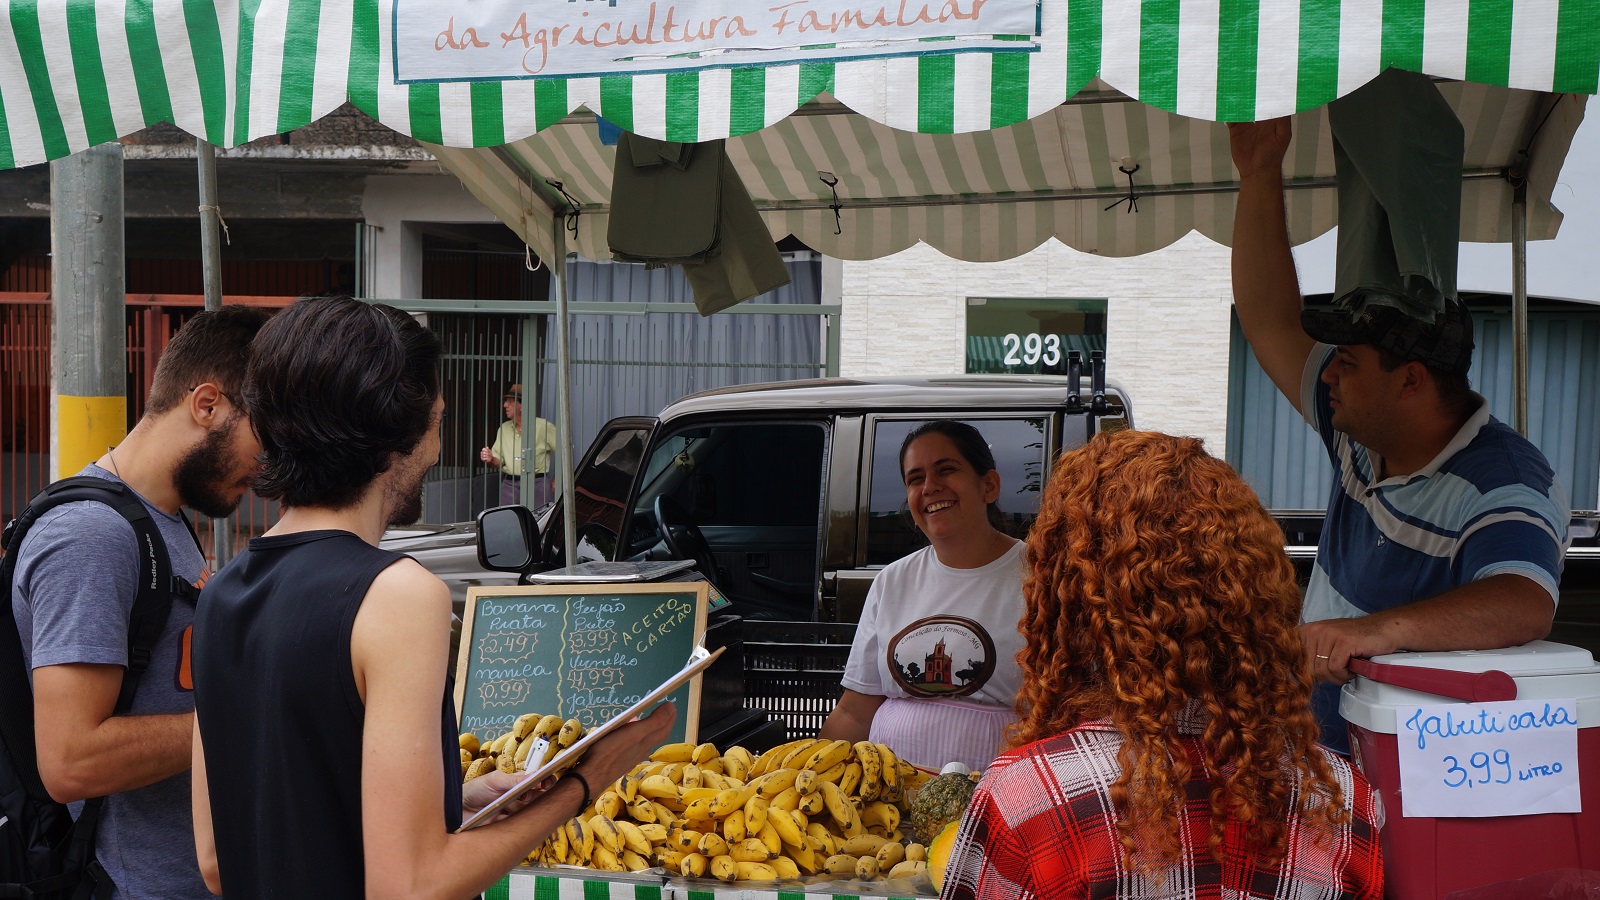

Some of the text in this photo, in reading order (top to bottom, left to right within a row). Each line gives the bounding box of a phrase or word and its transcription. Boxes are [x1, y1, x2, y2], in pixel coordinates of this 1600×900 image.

[434, 16, 491, 51] da
[500, 2, 758, 75] Agricultura
[1003, 333, 1060, 367] 293
[481, 600, 560, 617] Banana
[489, 614, 547, 630] Prata
[574, 617, 616, 632] Preto
[484, 634, 529, 653] 2,49
[571, 631, 610, 648] 3,99
[901, 626, 933, 645] Conceição
[933, 624, 942, 632] do
[573, 669, 616, 689] 4,99
[484, 681, 524, 700] 0,99
[1443, 749, 1512, 789] 3,99
